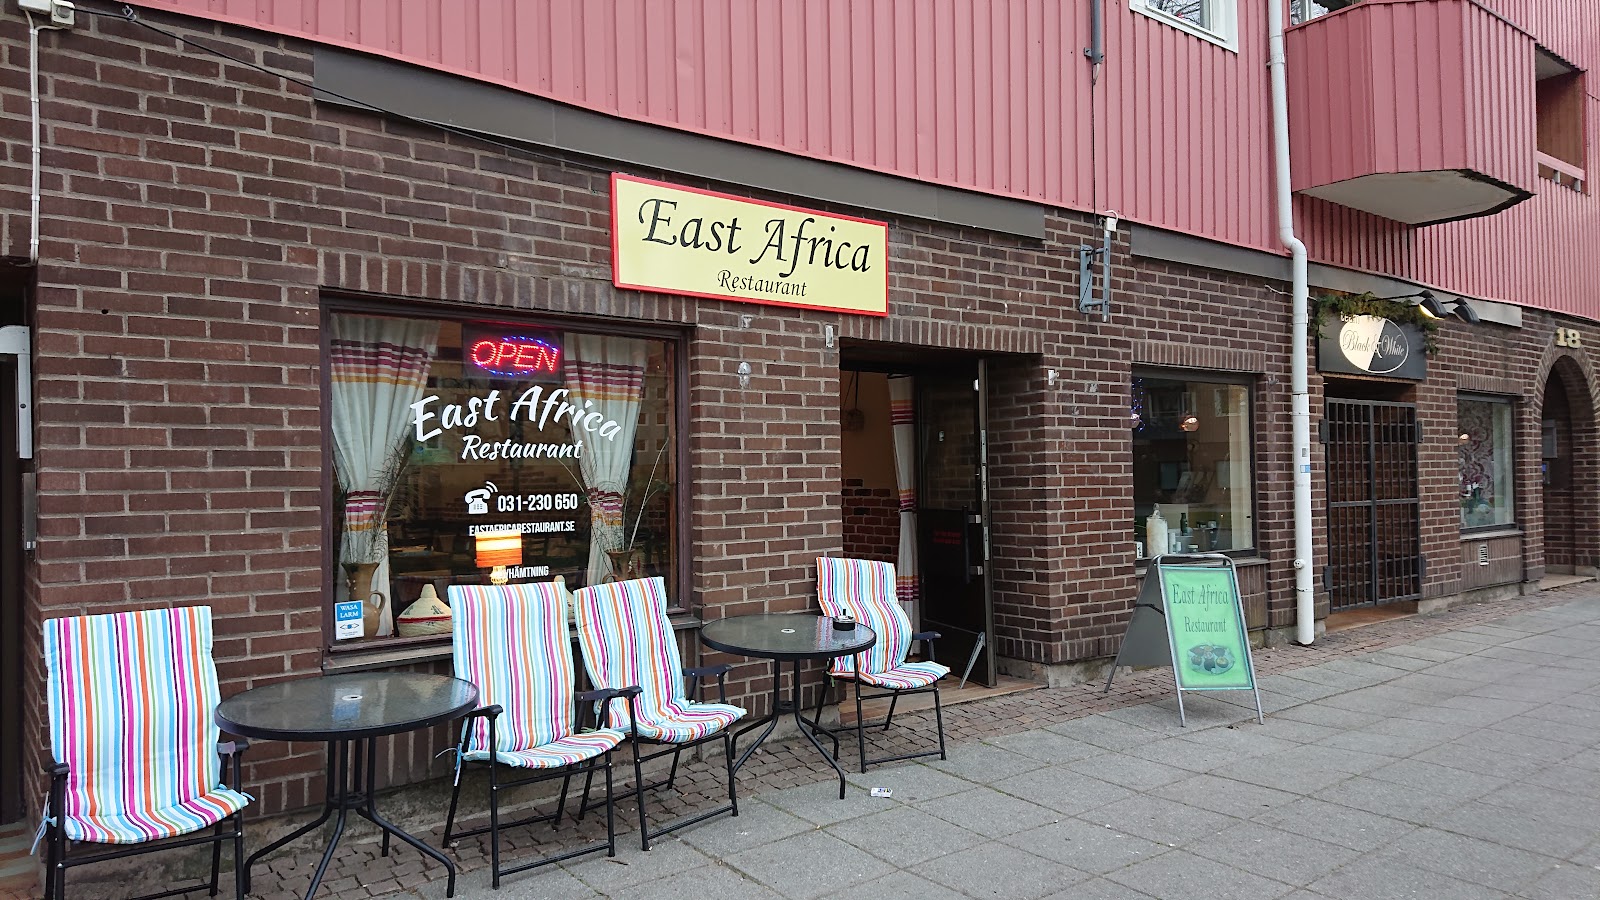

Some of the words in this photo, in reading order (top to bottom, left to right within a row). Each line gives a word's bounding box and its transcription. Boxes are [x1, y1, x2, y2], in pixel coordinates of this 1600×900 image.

[638, 198, 742, 254] East
[749, 217, 871, 278] Africa
[717, 269, 808, 297] Restaurant
[1342, 329, 1370, 353] Black
[1371, 333, 1383, 359] &
[1381, 334, 1405, 356] White
[1555, 326, 1581, 349] 18
[471, 340, 560, 372] OPEN
[409, 389, 500, 443] East
[509, 385, 622, 442] Africa
[461, 434, 584, 461] Restaurant
[497, 494, 552, 512] 031-230
[554, 493, 578, 510] 650
[1172, 583, 1195, 605] East
[1198, 583, 1229, 612] Africa
[1184, 616, 1227, 633] Restaurant
